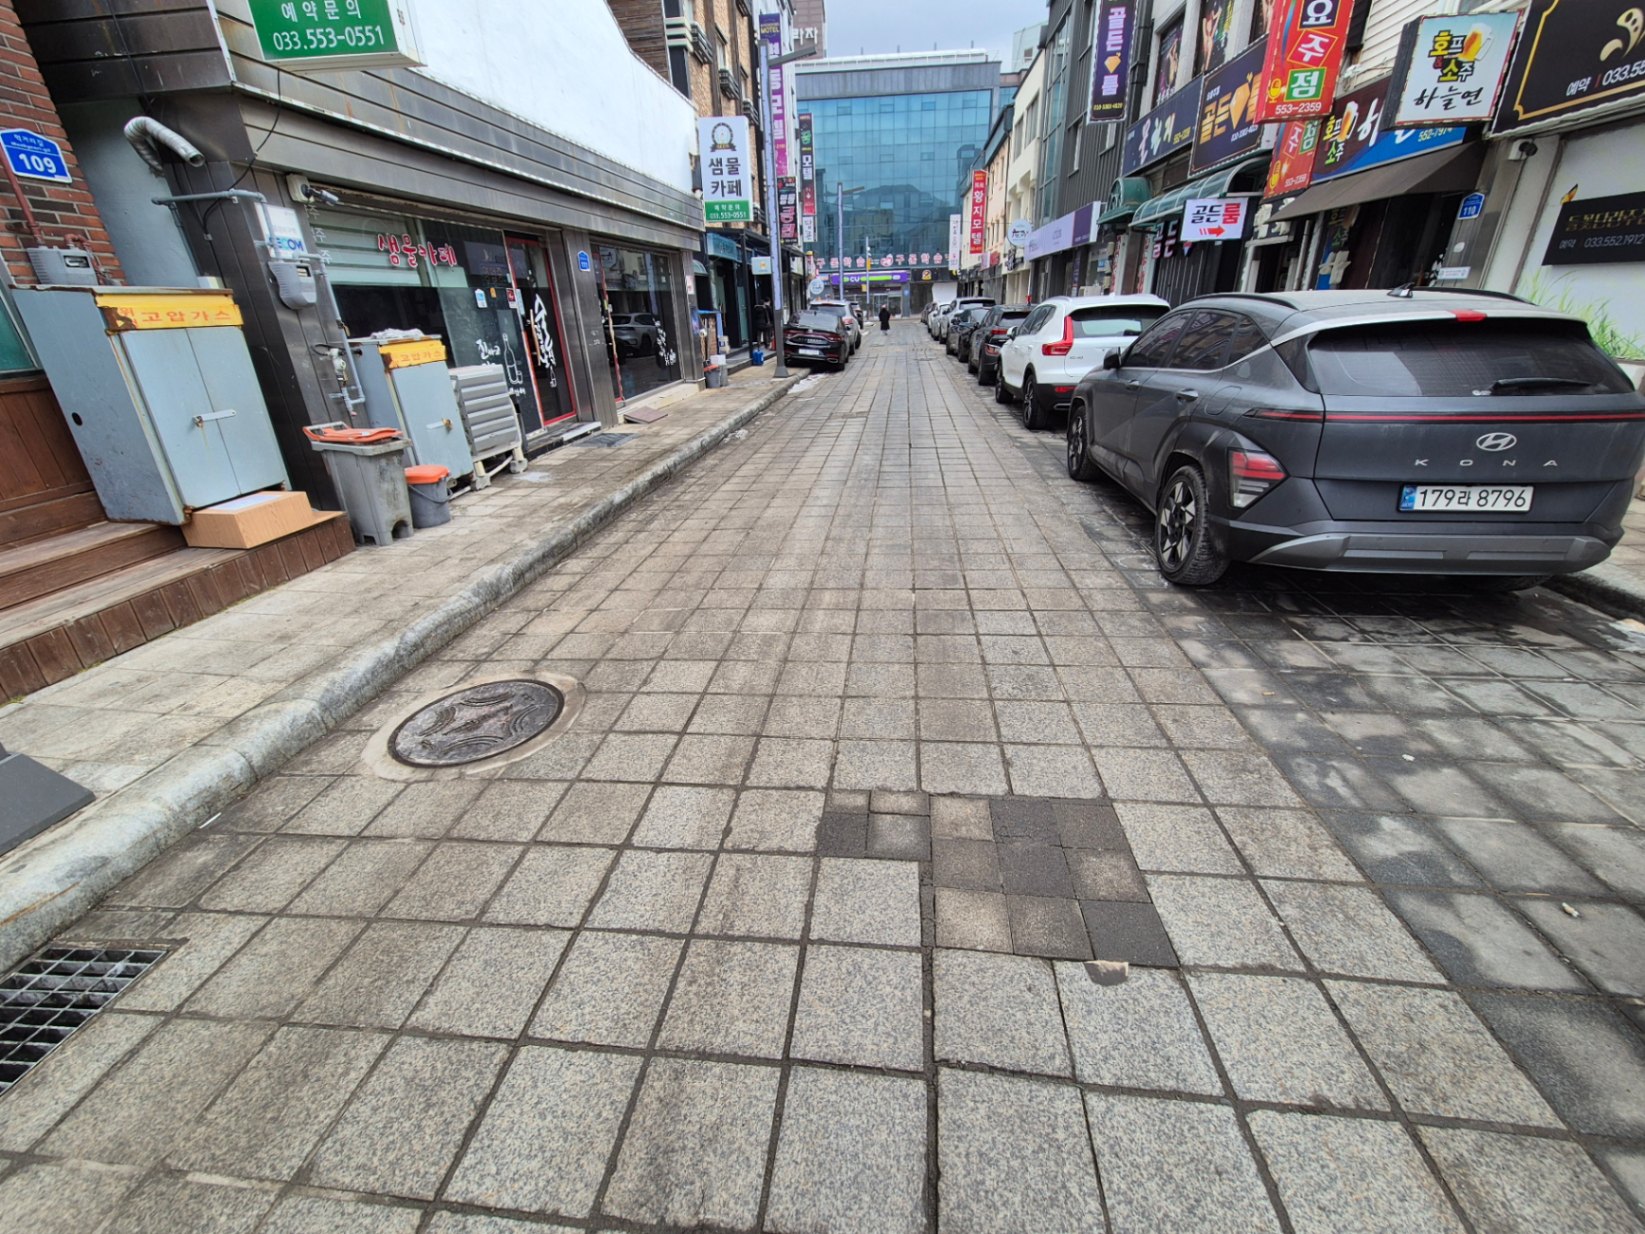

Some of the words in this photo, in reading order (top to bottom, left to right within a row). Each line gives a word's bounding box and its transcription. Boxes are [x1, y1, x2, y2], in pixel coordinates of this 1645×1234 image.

[273, 26, 384, 50] 033.553-0551
[1429, 30, 1465, 56] 호프
[1437, 58, 1474, 83] 소주
[1566, 76, 1591, 96] 예약
[1275, 102, 1321, 115] 553-2359
[1413, 86, 1484, 111] 하늘연
[1200, 91, 1232, 145] 골든
[19, 153, 57, 173] 109
[708, 157, 741, 176] 샘물
[711, 179, 742, 197] 카페
[1191, 202, 1241, 225] 골든룸
[1463, 205, 1477, 216] 110
[142, 310, 231, 323] 고압가스
[1414, 458, 1558, 467] KONA
[1477, 489, 1527, 508] 8796
